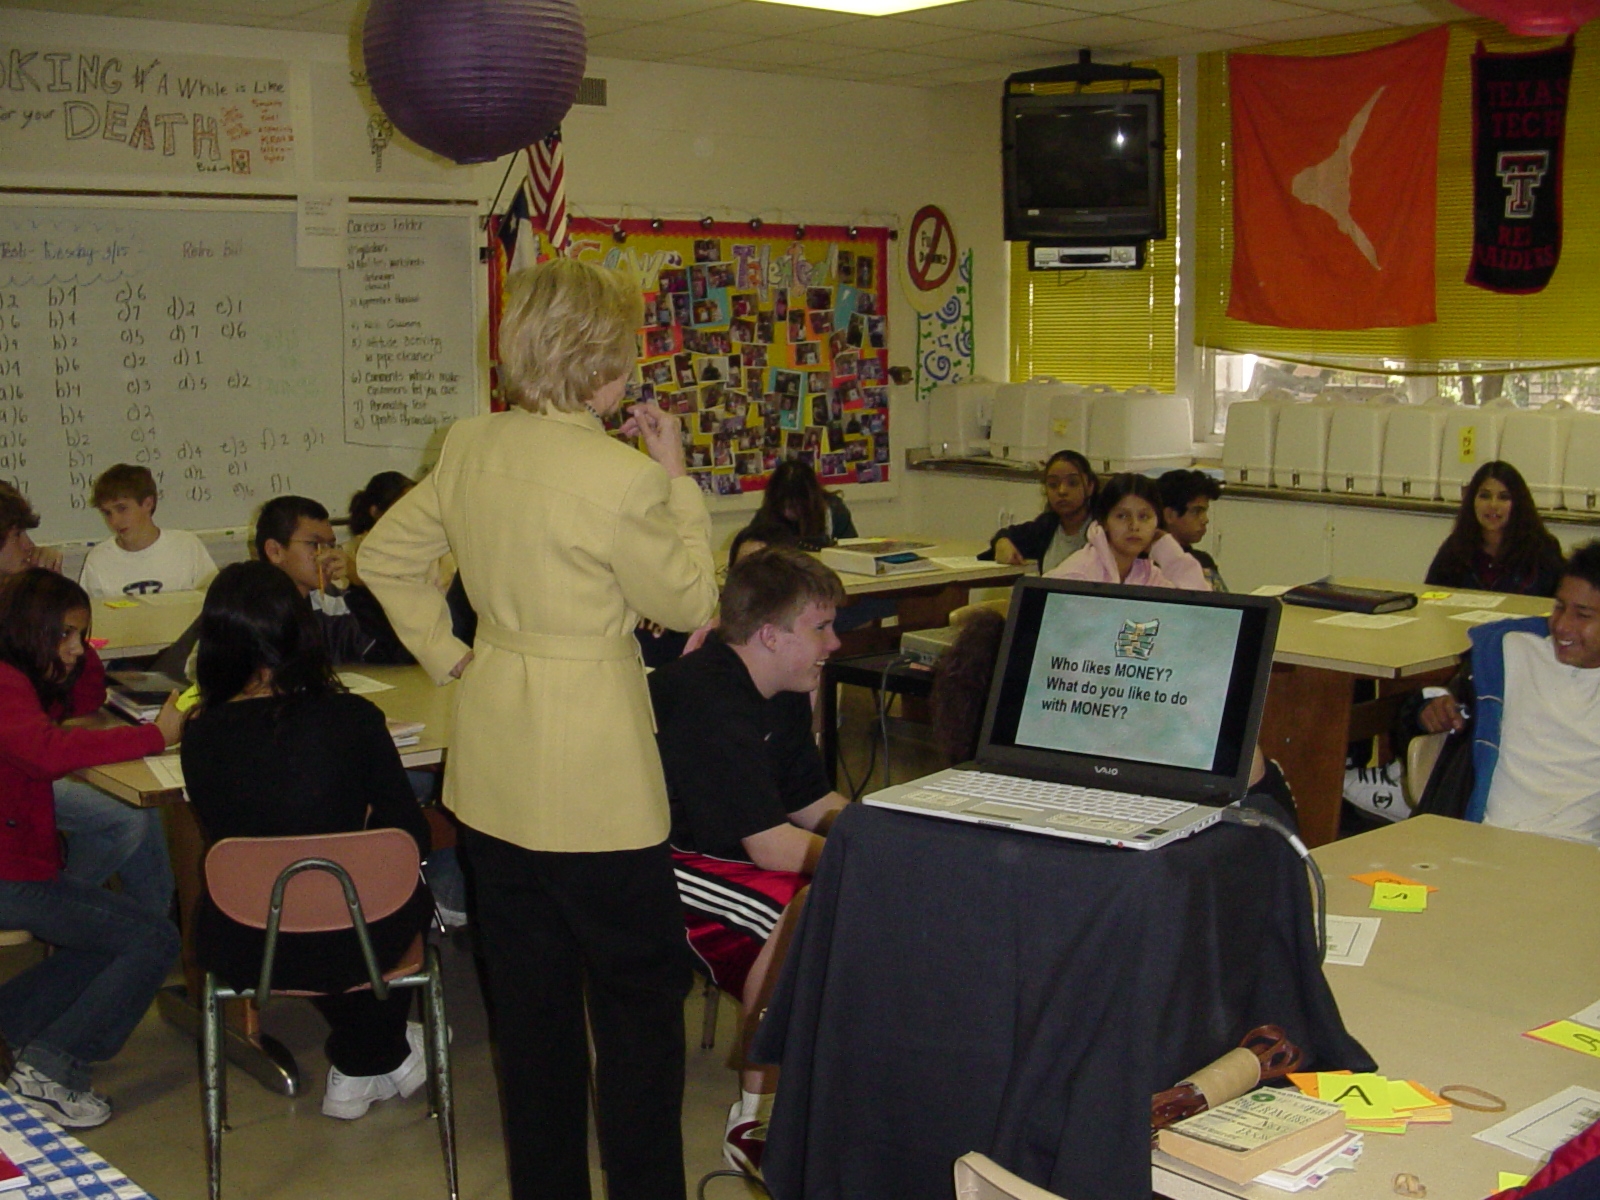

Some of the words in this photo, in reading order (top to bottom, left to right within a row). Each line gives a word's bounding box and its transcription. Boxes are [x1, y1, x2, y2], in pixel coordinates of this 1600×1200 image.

[0, 49, 122, 94] KING
[1487, 78, 1568, 108] TEXAS
[63, 100, 221, 161] DEATH
[1490, 110, 1563, 138] TECH
[1050, 656, 1079, 673] Who
[1081, 660, 1111, 676] likes
[1114, 663, 1173, 683] MONEY?
[1046, 676, 1078, 693] What
[1081, 681, 1097, 695] do
[1100, 684, 1125, 700] you
[1128, 685, 1151, 702] like
[1154, 689, 1167, 703] to
[1170, 690, 1188, 706] do
[1041, 697, 1067, 713] with
[1070, 700, 1128, 720] MONEY?
[1094, 765, 1119, 776] VAIO
[1333, 1085, 1374, 1106] A
